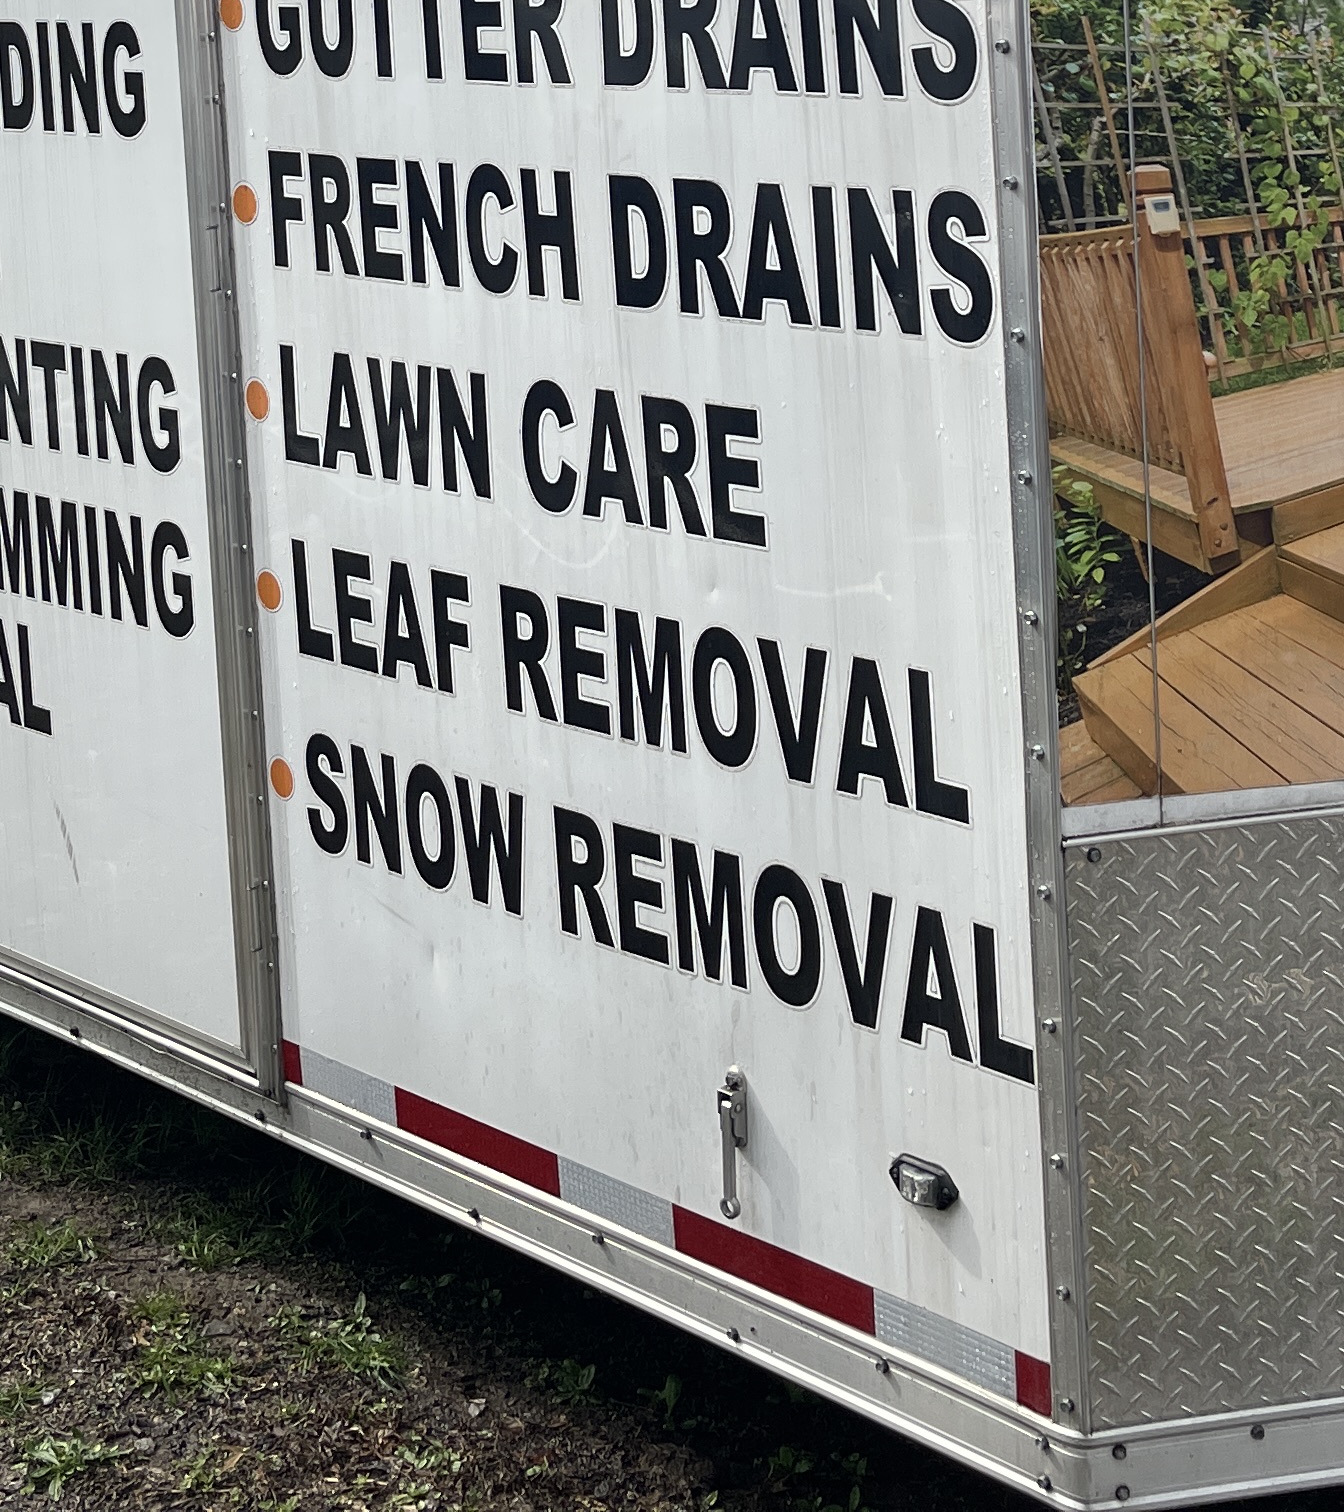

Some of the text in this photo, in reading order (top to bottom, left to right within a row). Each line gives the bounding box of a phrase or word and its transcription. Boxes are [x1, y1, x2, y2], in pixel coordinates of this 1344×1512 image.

[268, 150, 992, 343] FRENCH DRAINS
[280, 345, 766, 547] LAWN CARE
[291, 539, 969, 824] LEAF REMOVAL
[306, 734, 1035, 1085] SNOW REMOVAL
